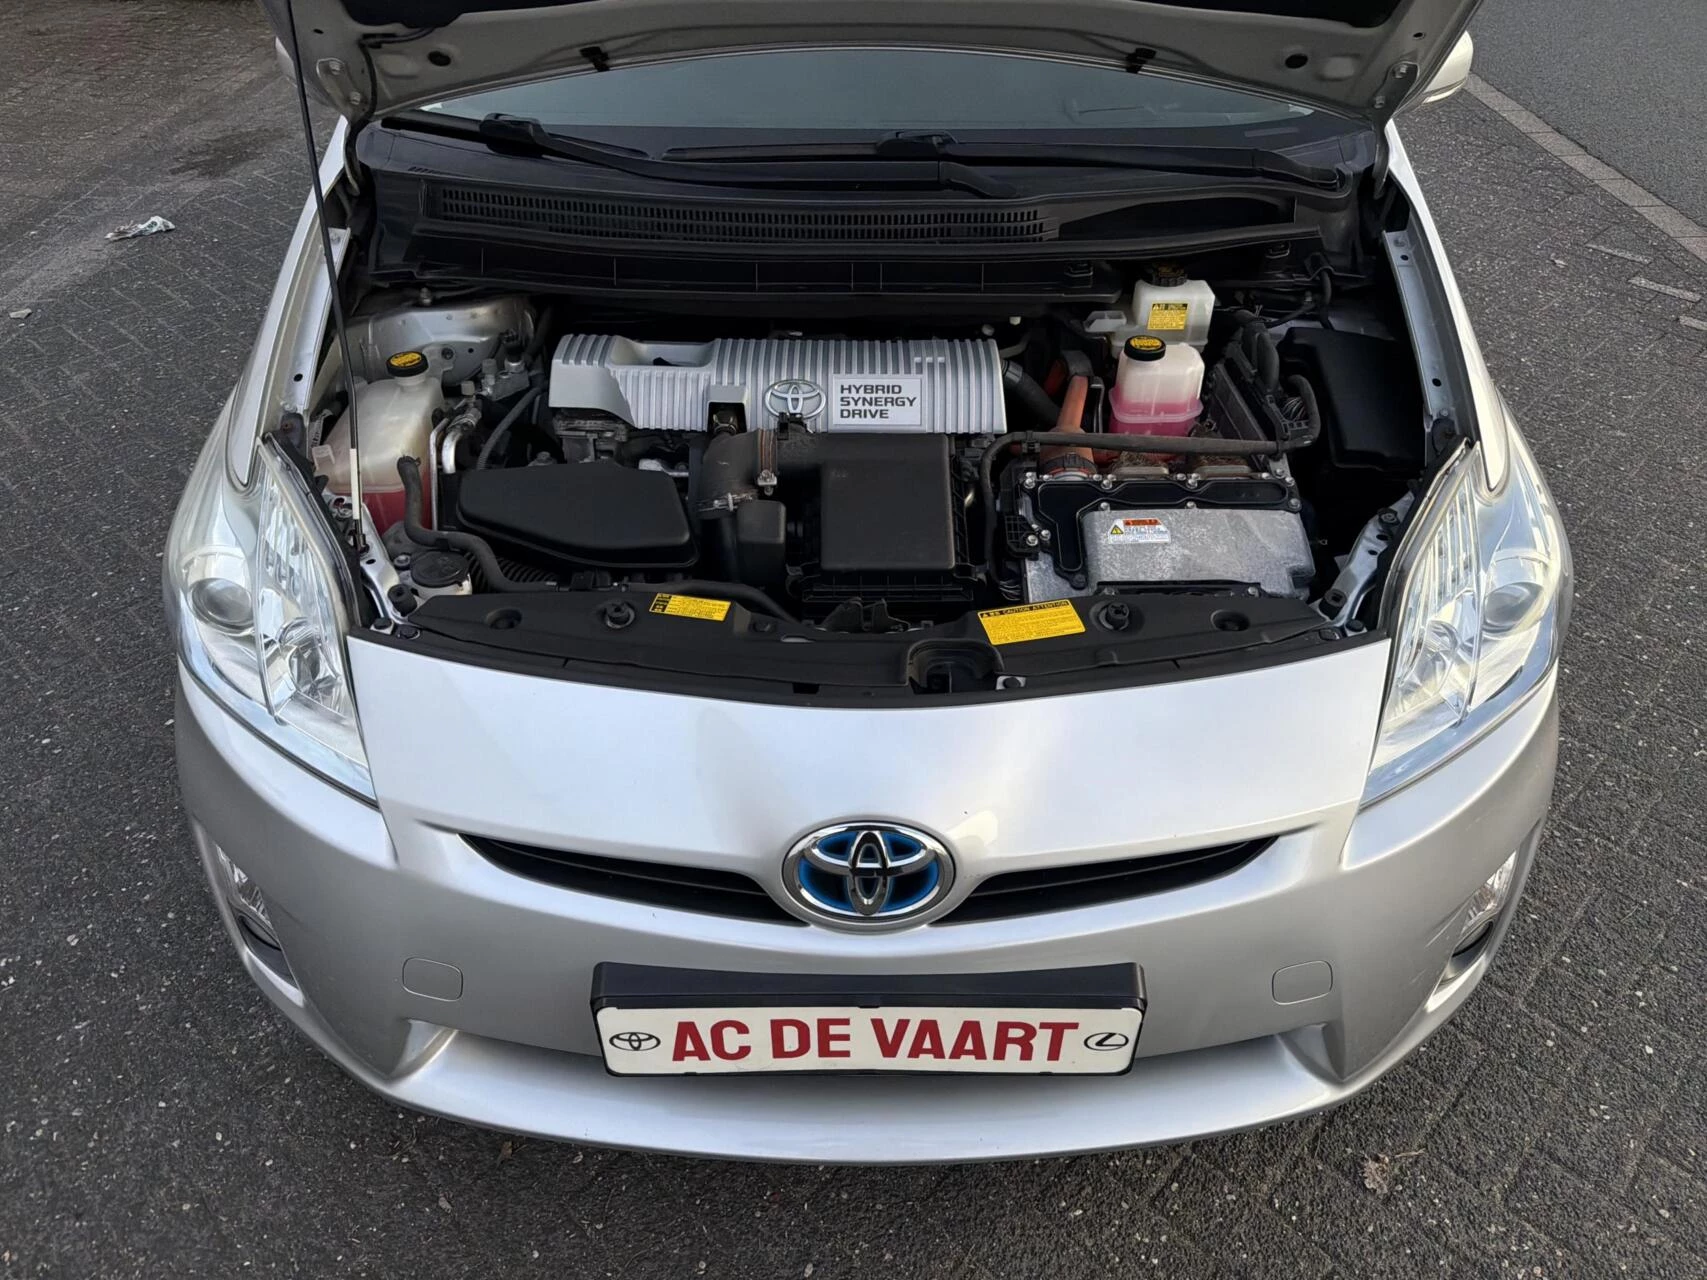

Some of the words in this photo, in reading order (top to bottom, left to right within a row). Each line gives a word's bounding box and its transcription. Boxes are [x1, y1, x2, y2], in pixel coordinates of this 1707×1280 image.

[840, 384, 902, 394] HYBRID
[840, 396, 917, 407] SYNERGY
[840, 408, 889, 419] DRIVE
[1003, 606, 1030, 614] CAUTION
[1032, 601, 1068, 610] ATTENTION
[671, 1019, 752, 1062] AC
[769, 1017, 852, 1059] DE
[870, 1017, 1080, 1062] VAART
